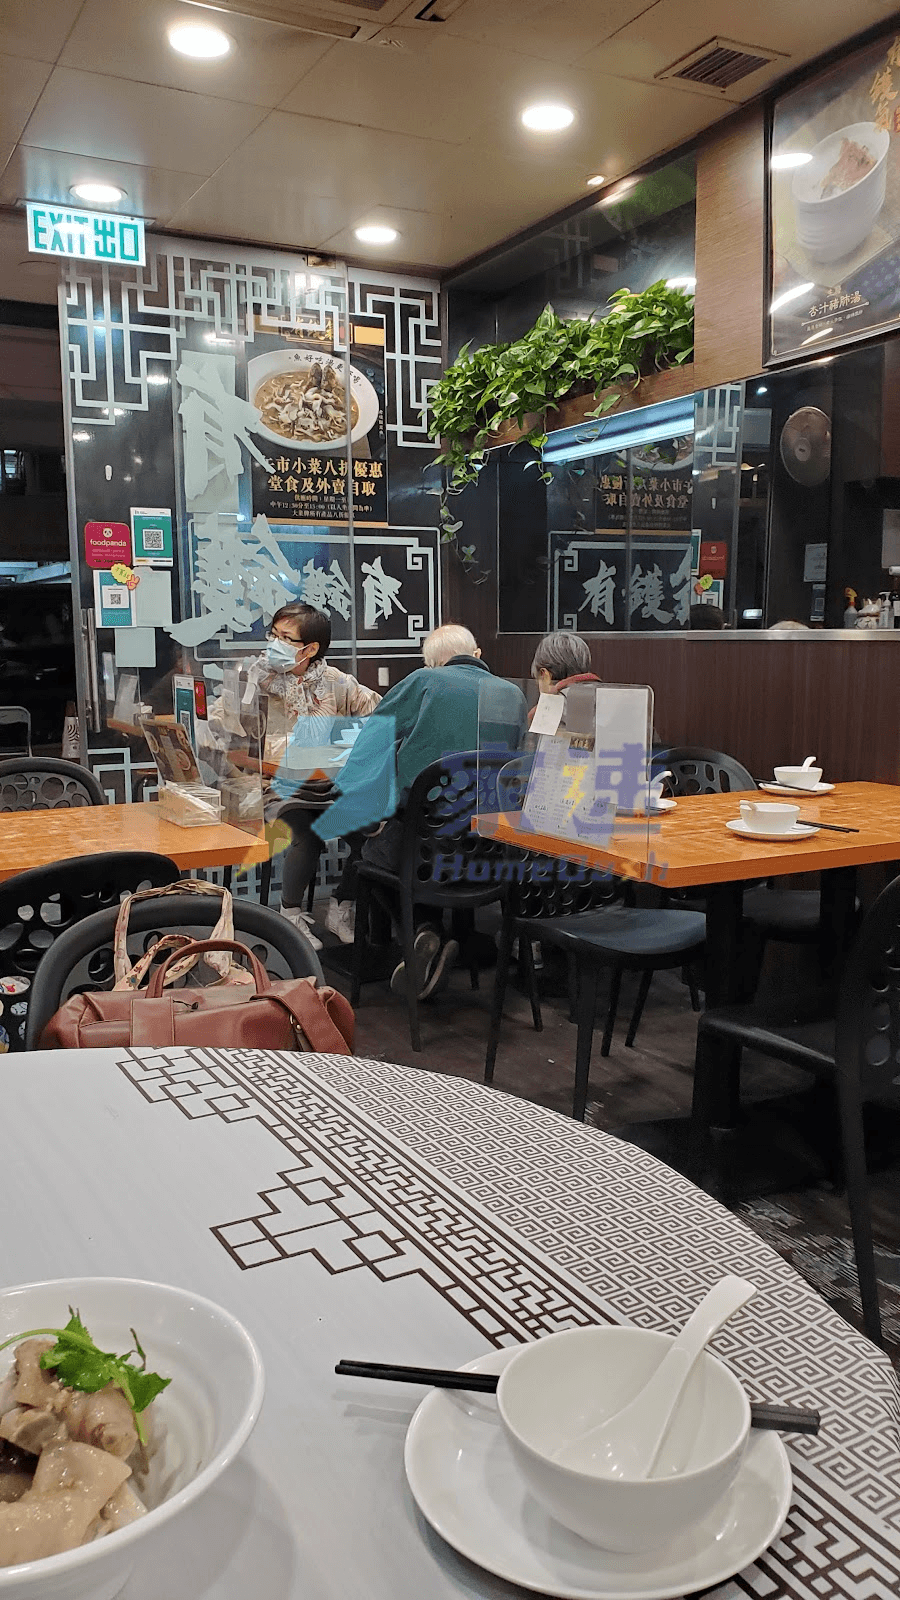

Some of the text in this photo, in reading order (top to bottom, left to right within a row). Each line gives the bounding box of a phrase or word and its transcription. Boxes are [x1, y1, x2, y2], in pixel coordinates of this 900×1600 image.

[33, 210, 140, 261] EXIT 出口
[267, 474, 376, 497] 堂食及外賣自取
[89, 538, 127, 547] foodpanda
